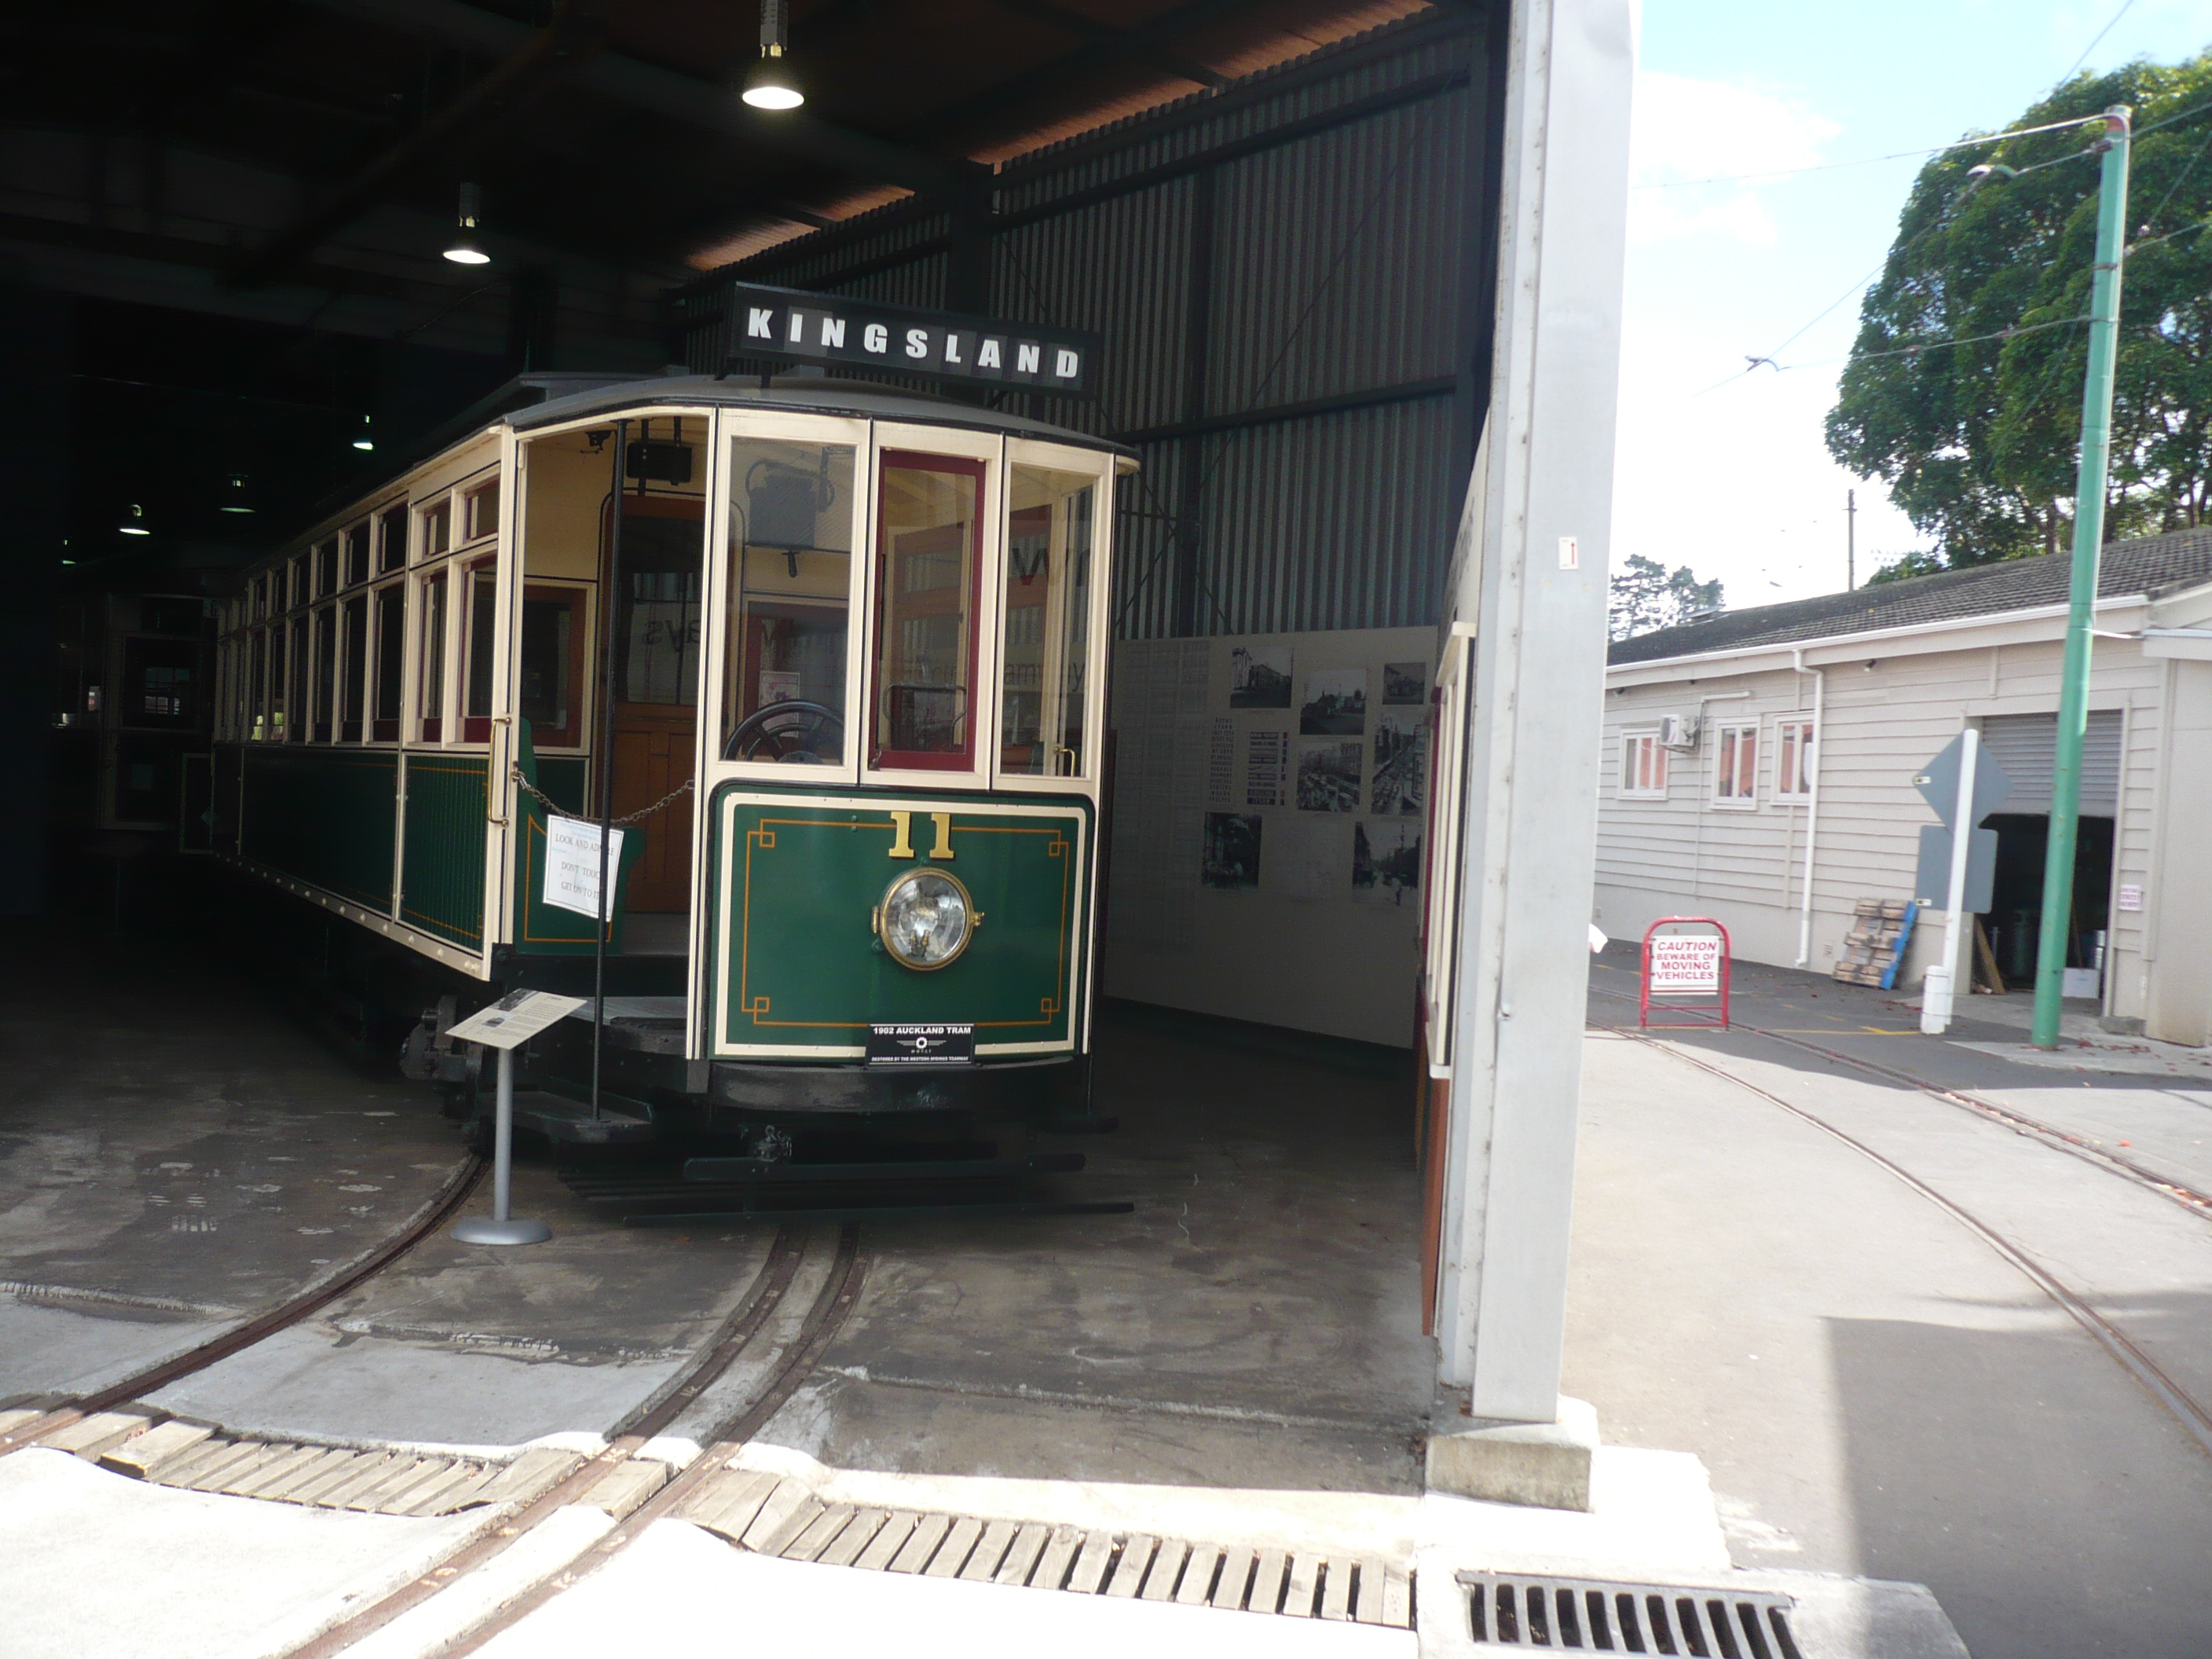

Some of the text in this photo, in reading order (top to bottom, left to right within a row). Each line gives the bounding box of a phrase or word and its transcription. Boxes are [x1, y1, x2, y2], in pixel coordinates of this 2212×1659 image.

[747, 307, 1079, 379] KINGSLAND
[555, 833, 573, 846] LOOK
[575, 838, 589, 849] AND
[888, 811, 954, 859] 11
[582, 867, 600, 880] TOUC
[1657, 942, 1717, 951] CAUTION
[1661, 961, 1711, 970] MOVING
